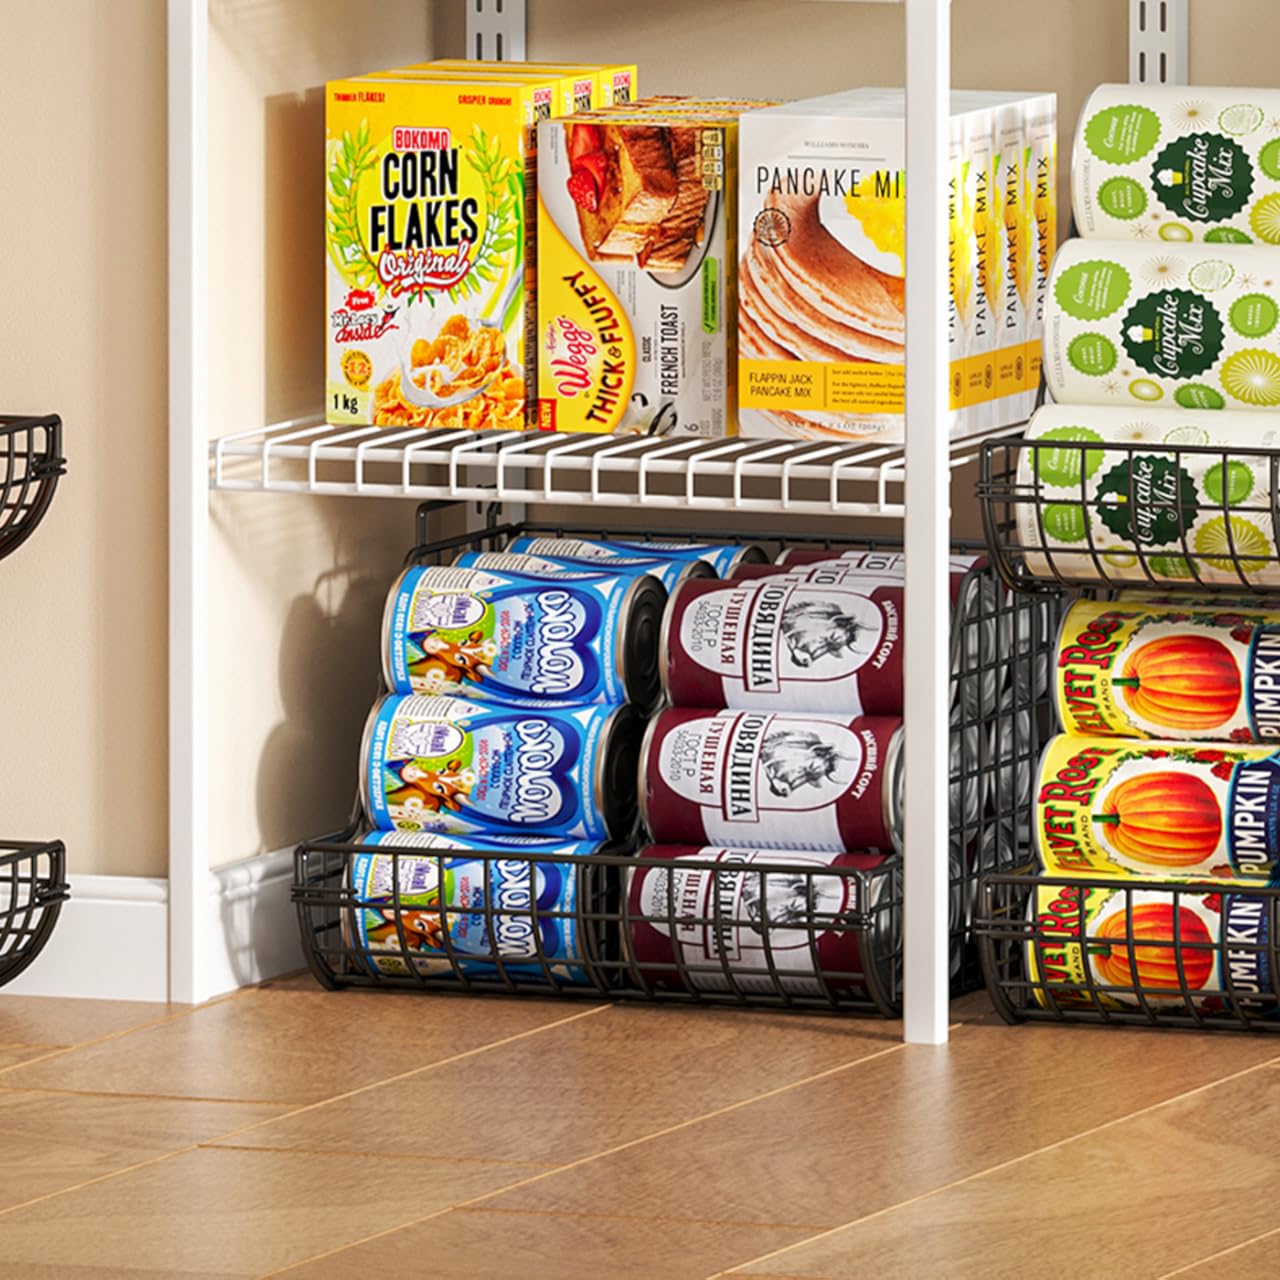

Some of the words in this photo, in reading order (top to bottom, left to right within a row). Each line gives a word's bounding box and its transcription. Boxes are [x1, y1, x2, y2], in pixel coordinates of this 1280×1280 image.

[395, 129, 448, 150] BOKOMO
[382, 150, 459, 200] CORN
[757, 165, 862, 198] PANCAKE
[875, 176, 905, 199] MI
[975, 170, 988, 215] MIX
[1006, 162, 1018, 207] MIX
[1182, 138, 1210, 220] Cupcake
[1208, 147, 1235, 199] Mix
[370, 198, 479, 252] FLAKES
[378, 240, 472, 286] Original
[975, 232, 987, 338] PANCAKE
[1005, 219, 1018, 330] PANCAKE
[562, 270, 625, 343] FLUFFY
[660, 304, 679, 341] TOAST
[1178, 303, 1206, 356] Mix
[611, 343, 623, 359] &
[642, 336, 652, 363] CLASSIC
[1153, 293, 1181, 377] Cupcake
[586, 360, 626, 425] THICK
[660, 345, 679, 396] FRENCH
[749, 372, 787, 384] FLAPPIN
[789, 373, 813, 385] JACK
[750, 385, 792, 398] PANCAKE
[794, 387, 813, 398] MIX
[333, 393, 339, 410] 1
[343, 394, 359, 415] kg
[540, 401, 554, 430] NEW
[708, 603, 724, 635] ГОСТ
[720, 591, 748, 666] ТУШЕНАЯ
[1100, 677, 1118, 720] BRAND
[699, 720, 727, 795] ТУШЕНАЯ
[731, 713, 768, 817] ГОВЯДИНА
[1234, 769, 1273, 875] PUMPKIN
